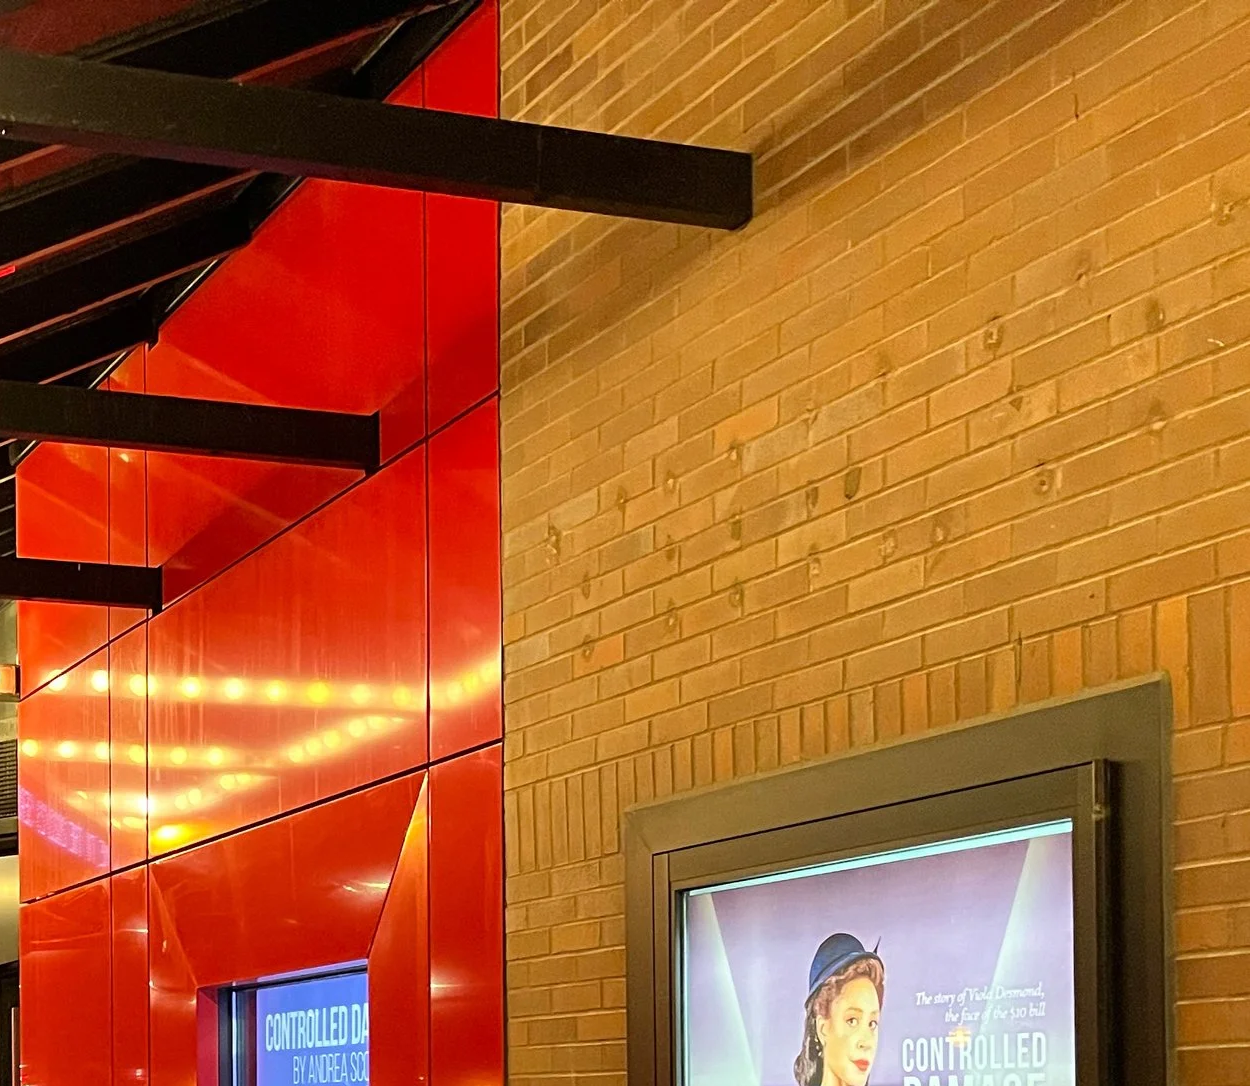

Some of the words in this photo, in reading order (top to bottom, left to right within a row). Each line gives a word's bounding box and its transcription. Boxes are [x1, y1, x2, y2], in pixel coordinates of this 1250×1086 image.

[915, 991, 932, 1006] The
[934, 992, 956, 1008] story
[944, 1008, 959, 1023] the
[1029, 1001, 1046, 1017] bill
[265, 1004, 349, 1052] CONTROLLED
[902, 1031, 1047, 1073] CONTROLLED
[293, 1055, 309, 1085] BY
[308, 1053, 349, 1084] ANDREA
